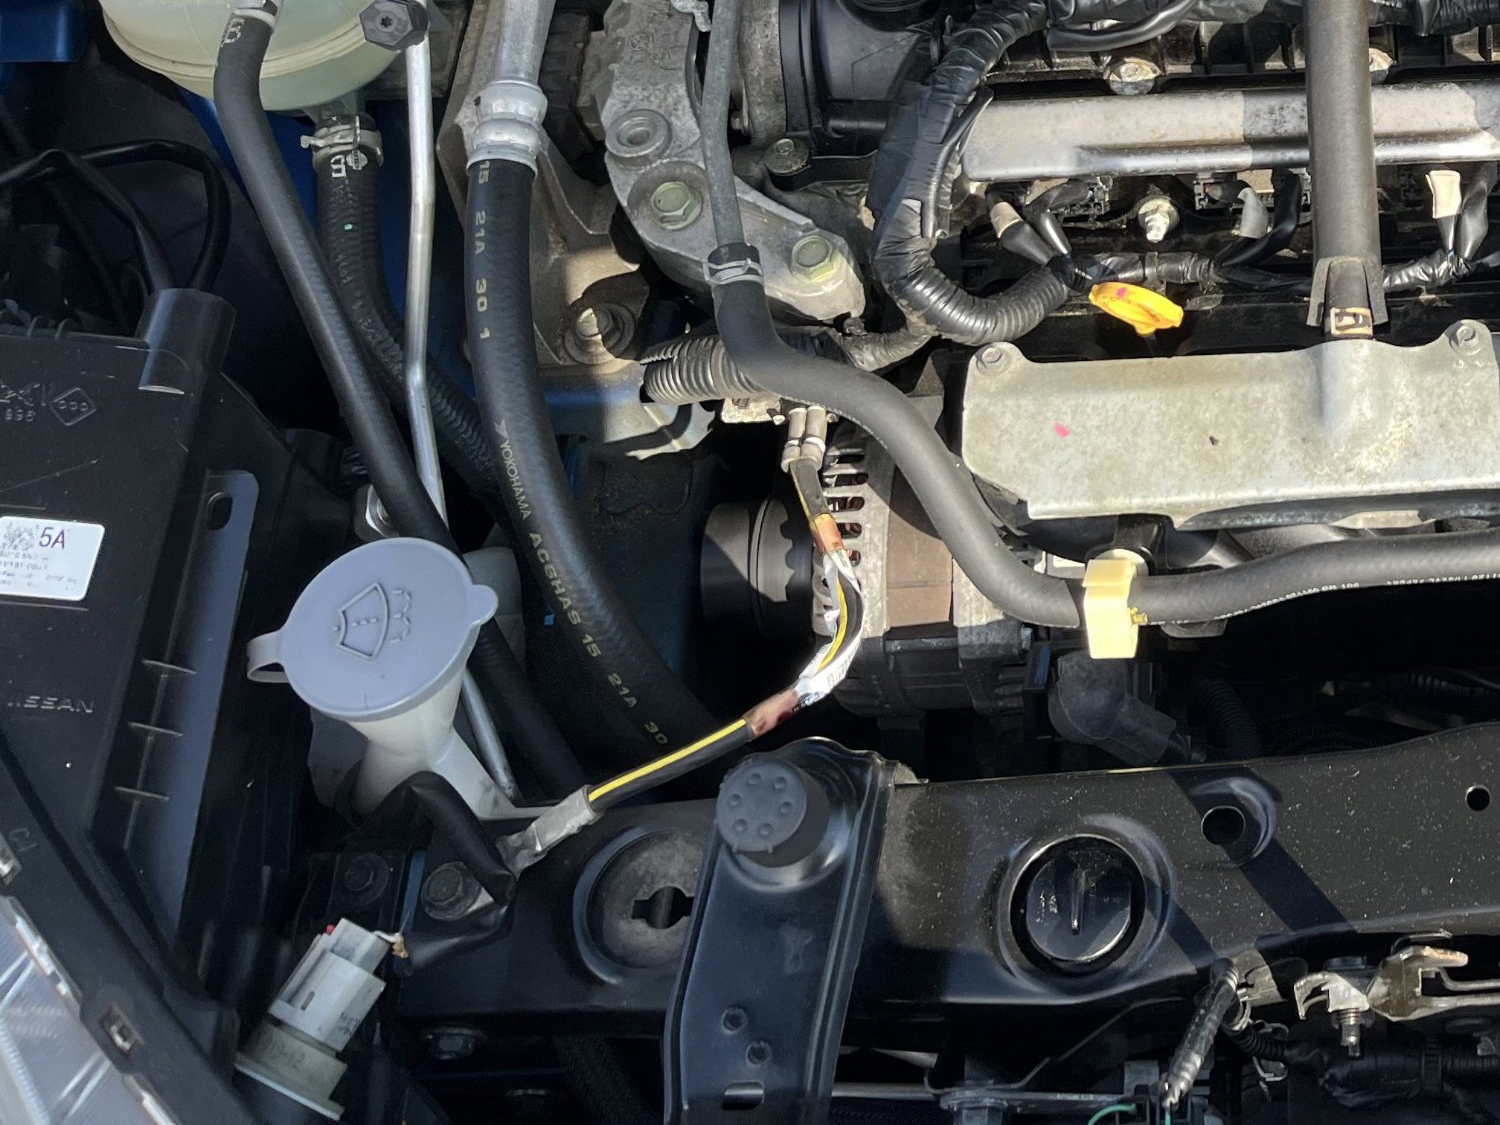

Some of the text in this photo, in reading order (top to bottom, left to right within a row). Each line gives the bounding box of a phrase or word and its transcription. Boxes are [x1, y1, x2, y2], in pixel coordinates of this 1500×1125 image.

[474, 210, 487, 255] 21A
[475, 277, 488, 313] 30
[38, 526, 66, 550] 5A
[500, 439, 531, 521] YOKOHAMA
[581, 633, 602, 658] 15
[607, 672, 639, 708] 21A
[7, 695, 94, 714] SSAN
